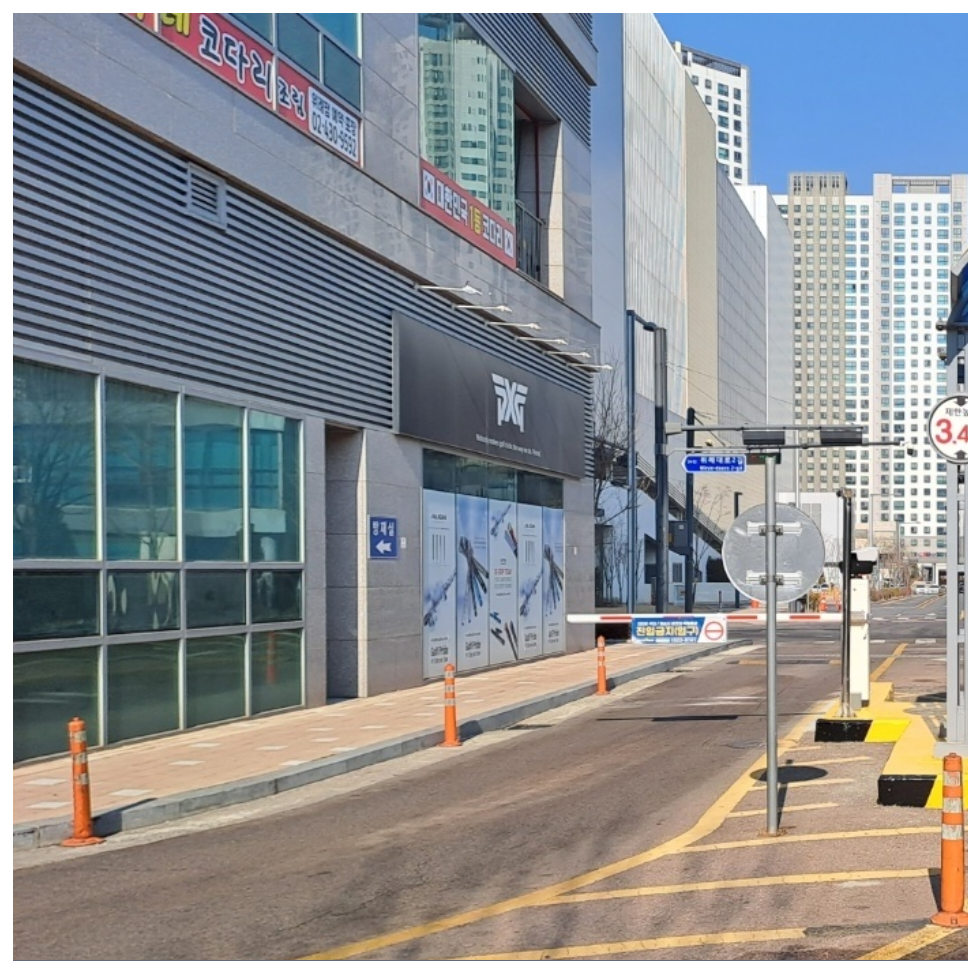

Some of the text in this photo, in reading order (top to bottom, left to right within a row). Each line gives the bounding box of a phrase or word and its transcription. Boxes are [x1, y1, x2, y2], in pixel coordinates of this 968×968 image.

[200, 13, 306, 120] 코다리 조림
[436, 180, 469, 227] 대한민국
[482, 213, 503, 249] 코다리
[372, 520, 395, 537] 방재실
[636, 625, 699, 637] 진입금지(입구)
